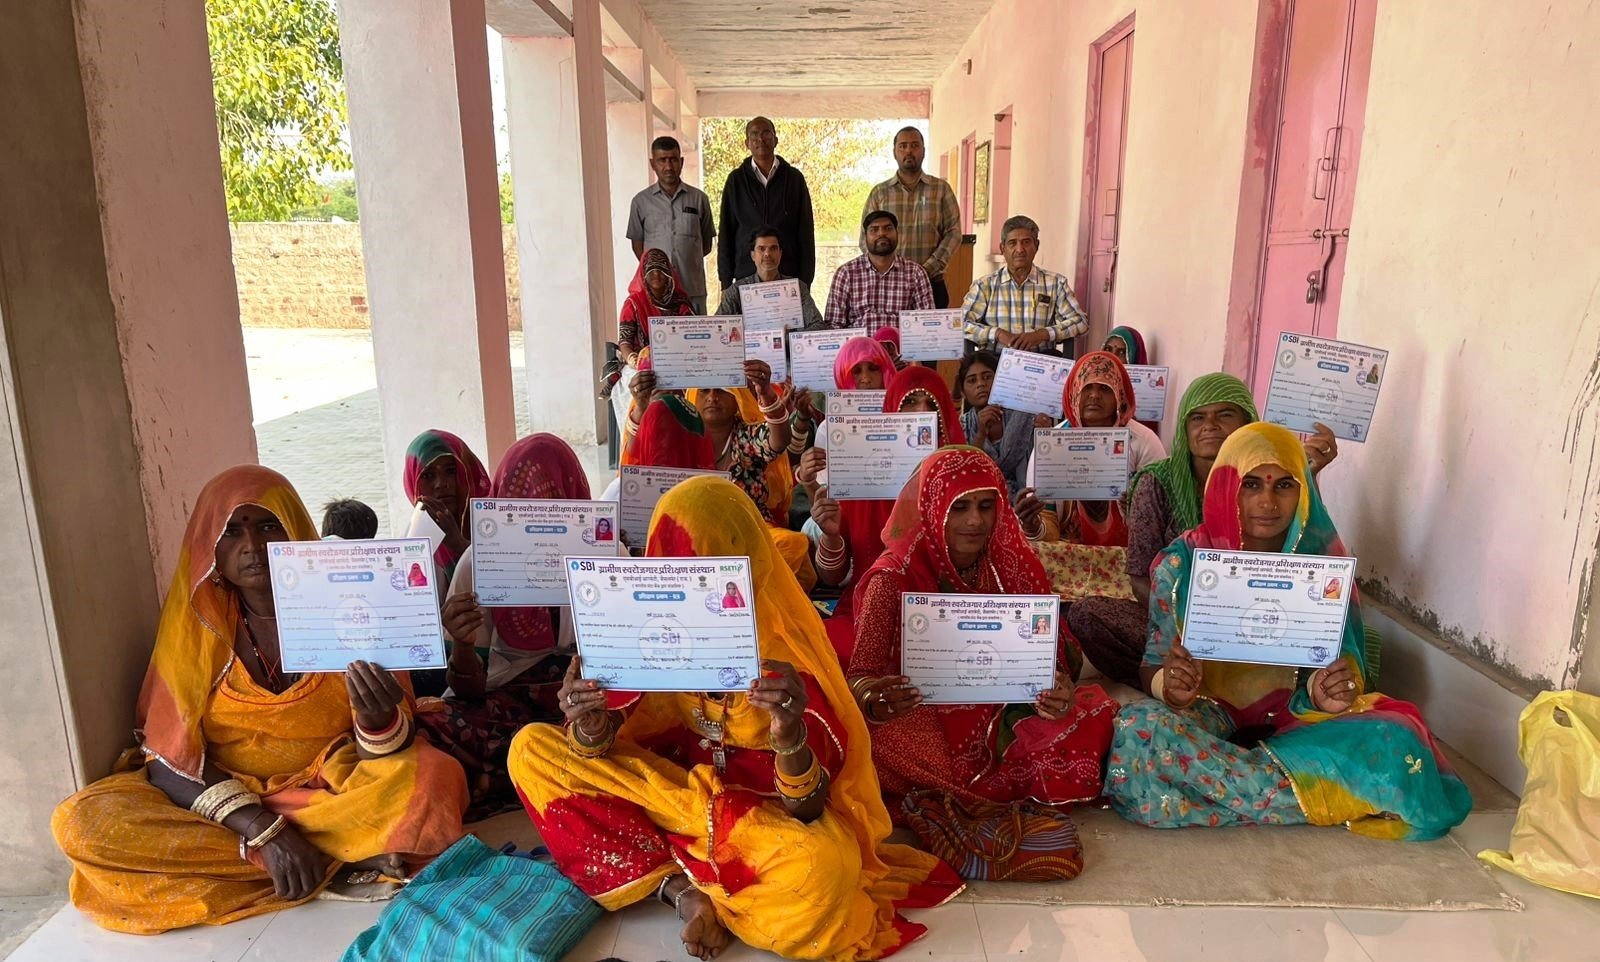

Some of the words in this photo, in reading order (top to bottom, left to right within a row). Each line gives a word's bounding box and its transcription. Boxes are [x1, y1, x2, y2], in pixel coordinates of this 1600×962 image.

[1288, 335, 1299, 344] SBI
[483, 501, 496, 510] SBI
[281, 546, 295, 556] SBI
[544, 558, 560, 568] SBI
[1207, 553, 1221, 562] SBI
[1222, 556, 1244, 565] ग्रामीण
[1244, 557, 1276, 567] स्वरोजगार
[1275, 559, 1303, 568] प्रशिक्षण
[1302, 560, 1325, 570] संस्थान
[580, 561, 596, 571] SBI
[598, 563, 622, 574] ग्रामीण
[622, 564, 659, 574] स्वरोजगार
[659, 563, 689, 574] प्रशिक्षण
[689, 564, 716, 574] संस्थान
[914, 596, 928, 605] SBI
[931, 599, 951, 608] ग्रामीण
[951, 599, 982, 608] स्वरोजगार
[982, 599, 1008, 608] प्रशिक्षण
[1261, 614, 1279, 625] SBI
[661, 632, 681, 644] SBI
[976, 655, 993, 666] SBI
